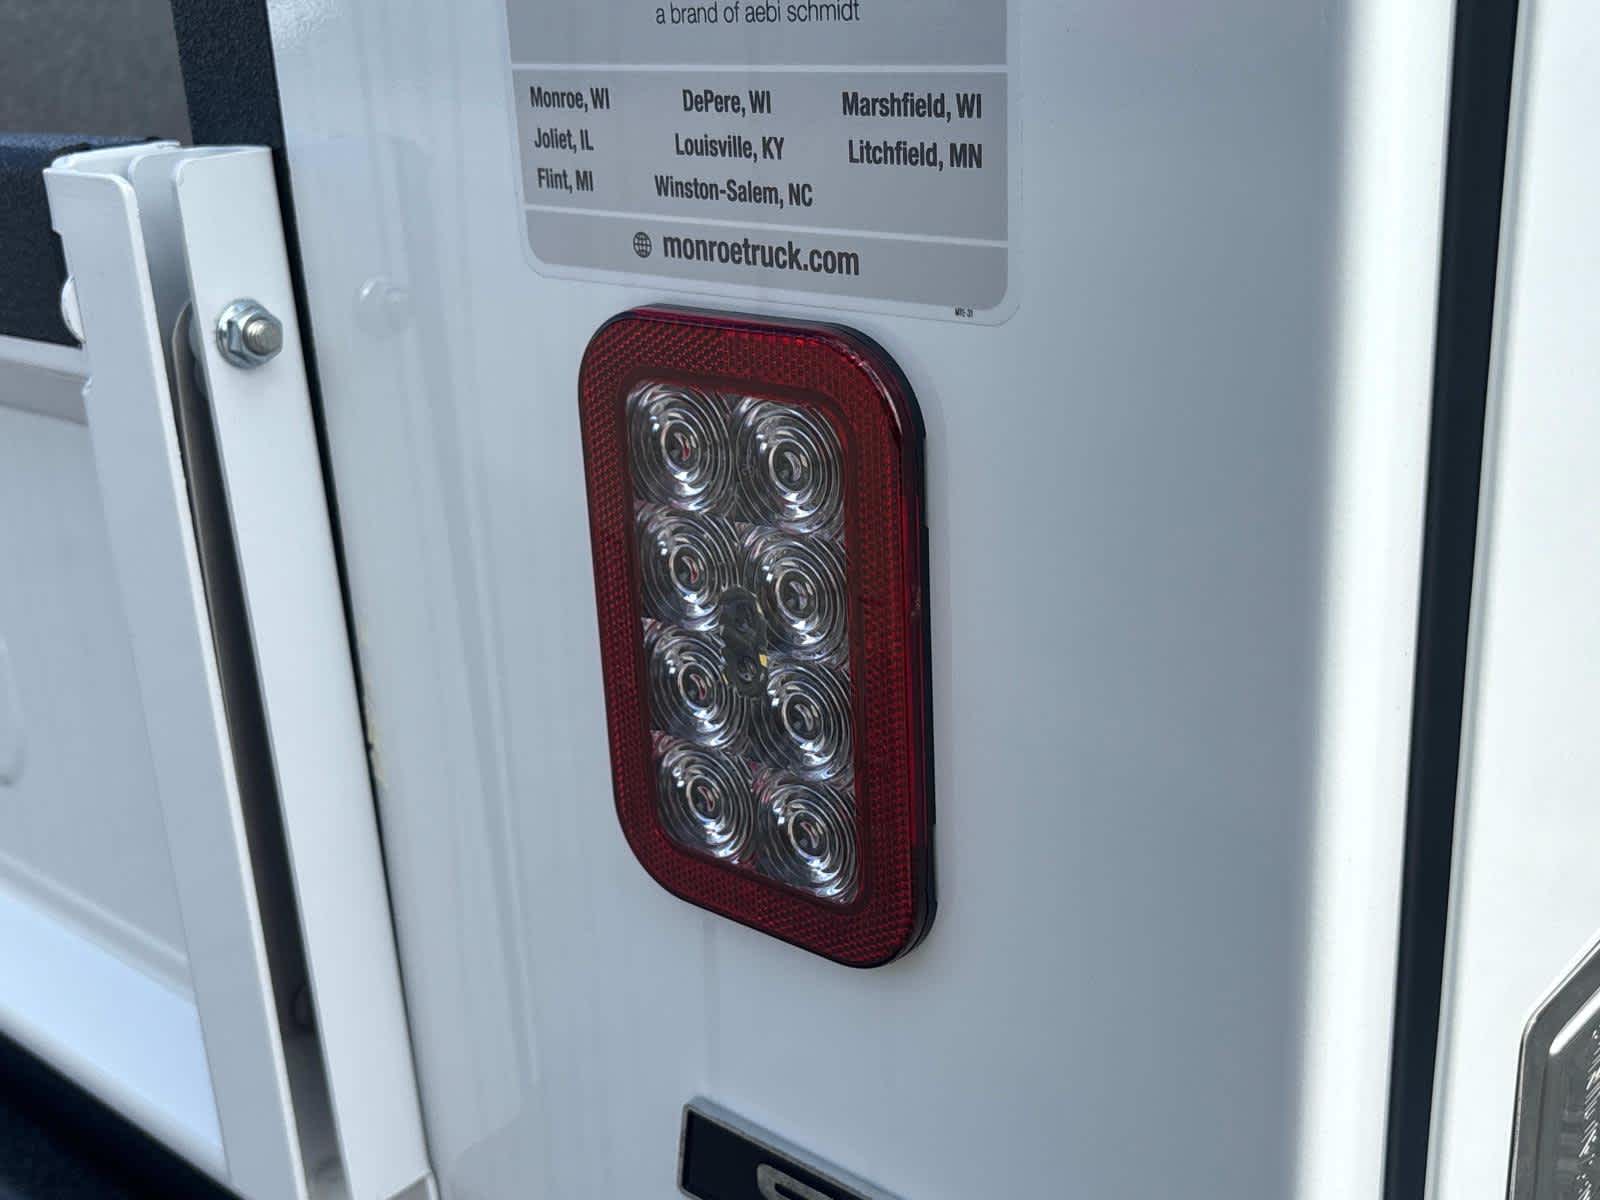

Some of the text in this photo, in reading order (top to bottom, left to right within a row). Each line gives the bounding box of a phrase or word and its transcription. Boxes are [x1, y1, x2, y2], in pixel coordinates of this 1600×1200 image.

[656, 0, 860, 24] a brand of aebi schmidt
[530, 86, 610, 112] Monroe, WI
[682, 89, 771, 118] DePere, WI
[842, 92, 981, 122] Marshfield, WI
[534, 128, 594, 154] Joliet, IL
[675, 133, 784, 163] Louisville, KY
[849, 139, 982, 171] Litchfield, MN
[537, 168, 593, 194] Flint, MI
[654, 174, 813, 209] Winston-Salem, NC
[663, 236, 859, 276] monroetruck.com
